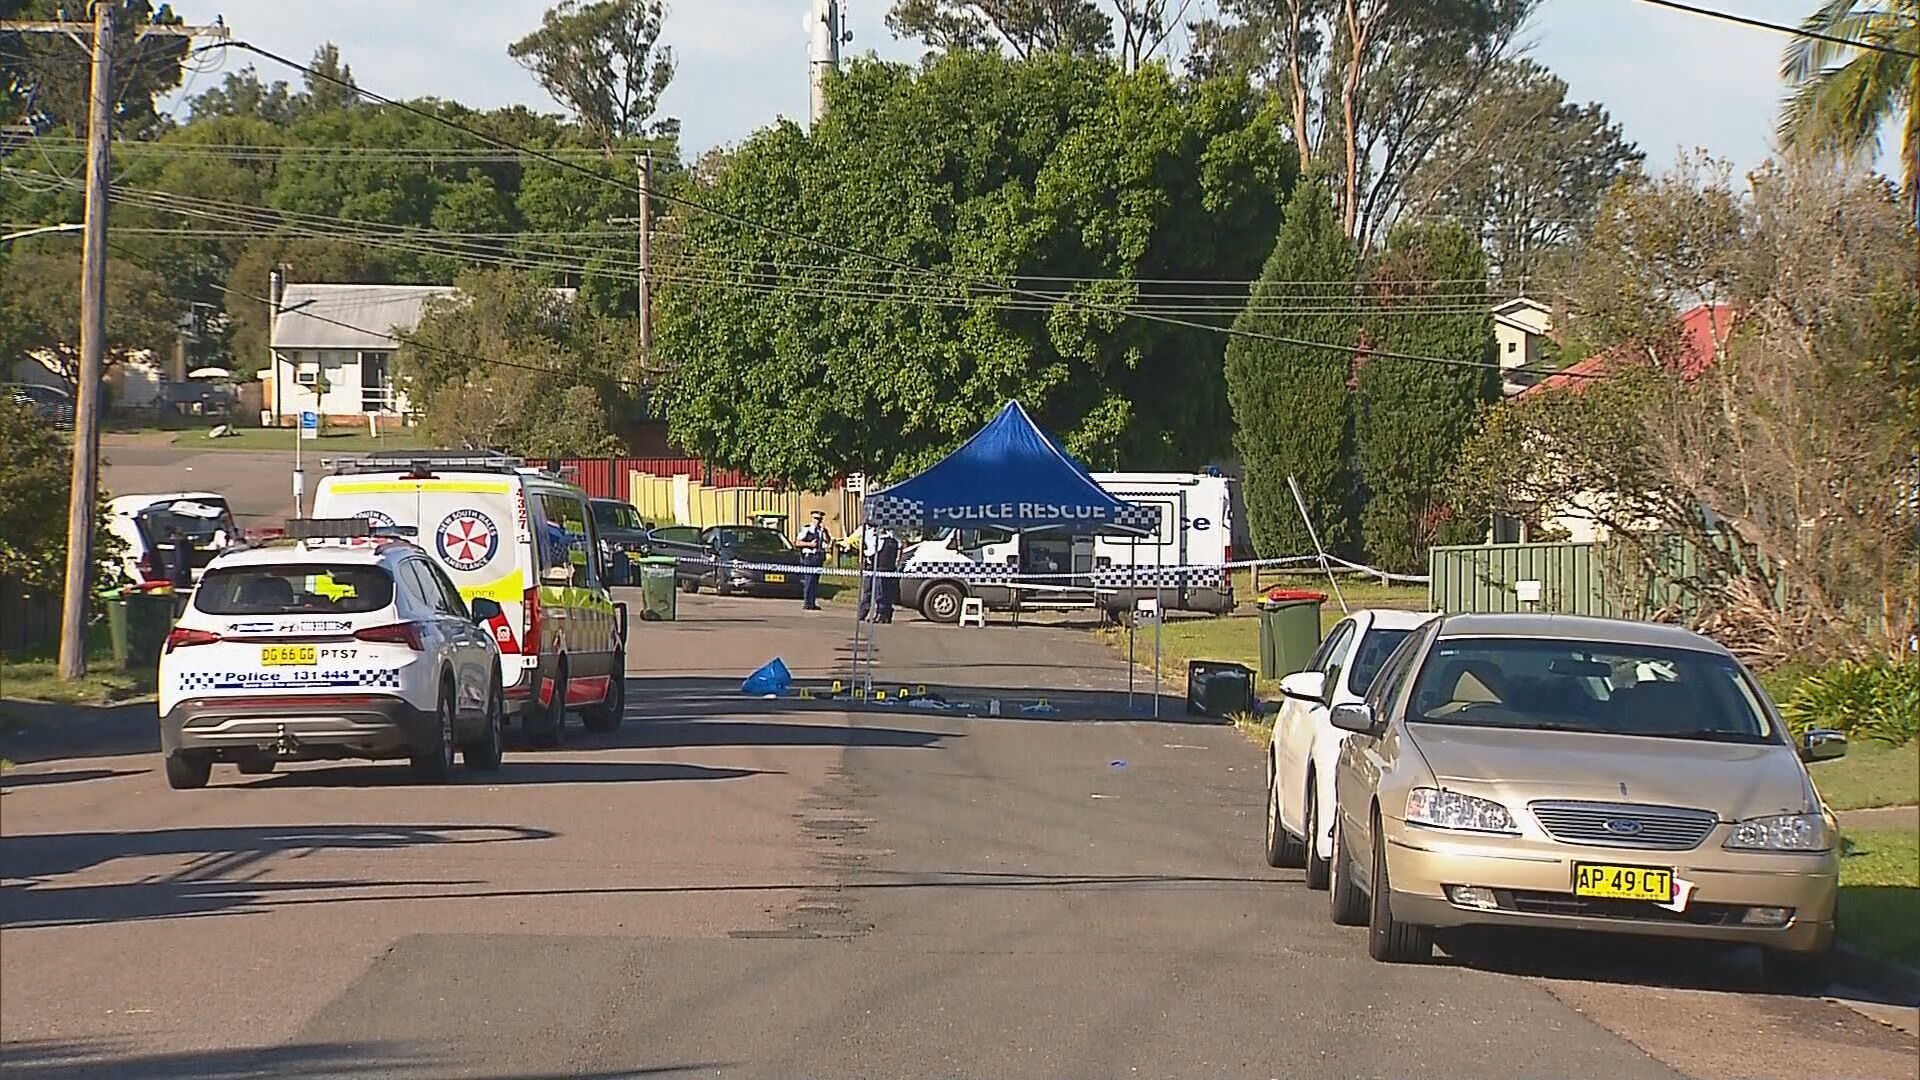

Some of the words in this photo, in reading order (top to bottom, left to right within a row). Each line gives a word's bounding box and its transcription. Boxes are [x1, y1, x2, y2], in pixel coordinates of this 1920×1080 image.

[516, 488, 527, 530] 4327
[933, 502, 1013, 520] POLICE
[1018, 501, 1107, 519] RESCUE
[451, 510, 478, 520] SOUTH
[477, 513, 497, 537] WALES
[443, 556, 489, 570] AMBULANCE
[280, 647, 296, 660] 66
[320, 649, 359, 660] PTS7
[224, 671, 281, 682] Police
[293, 671, 318, 680] 131
[321, 670, 350, 680] 444
[1578, 868, 1604, 889] AP
[1611, 870, 1636, 891] 49
[1643, 872, 1669, 894] CT
